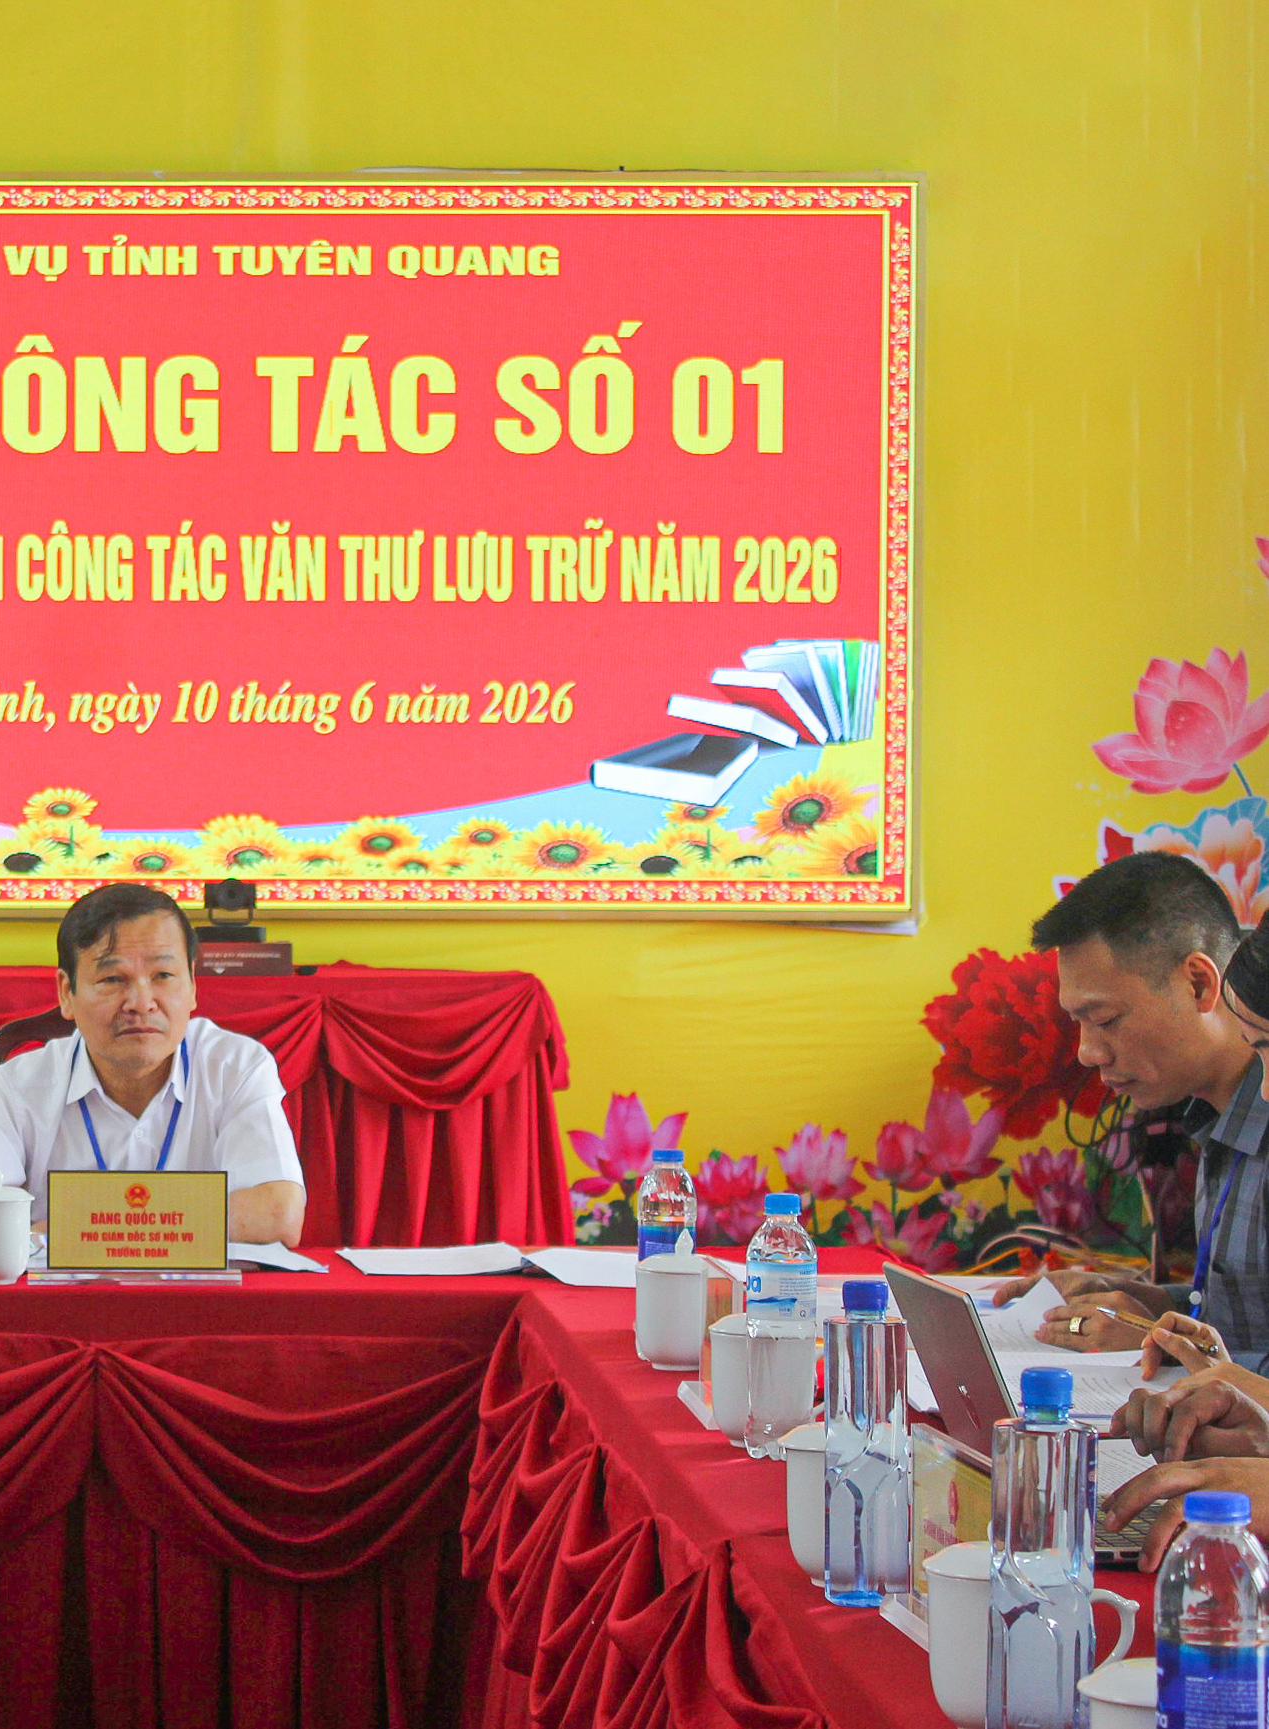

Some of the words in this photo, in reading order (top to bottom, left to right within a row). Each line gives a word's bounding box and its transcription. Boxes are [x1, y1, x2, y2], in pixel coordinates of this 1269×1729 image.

[3, 245, 68, 282] VỤ
[82, 234, 198, 276] TỈNH
[212, 240, 372, 276] TUYÊN
[388, 244, 560, 279] QUANG
[255, 334, 457, 455] TÁC
[494, 320, 643, 455] SỐ
[671, 356, 784, 455] 01
[16, 520, 134, 602] CÔNG
[146, 520, 227, 602] TÁC
[240, 521, 327, 602] VĂN
[339, 529, 424, 602] THƯ
[434, 531, 514, 602] LƯU
[526, 518, 612, 602] TRỮ
[620, 522, 720, 602] NĂM
[733, 536, 839, 603] 2026
[68, 682, 162, 734] ngày
[172, 681, 219, 723] 10
[229, 680, 342, 735] tháng
[350, 681, 377, 724] 6
[385, 684, 471, 724] năm
[479, 680, 576, 724] 2026
